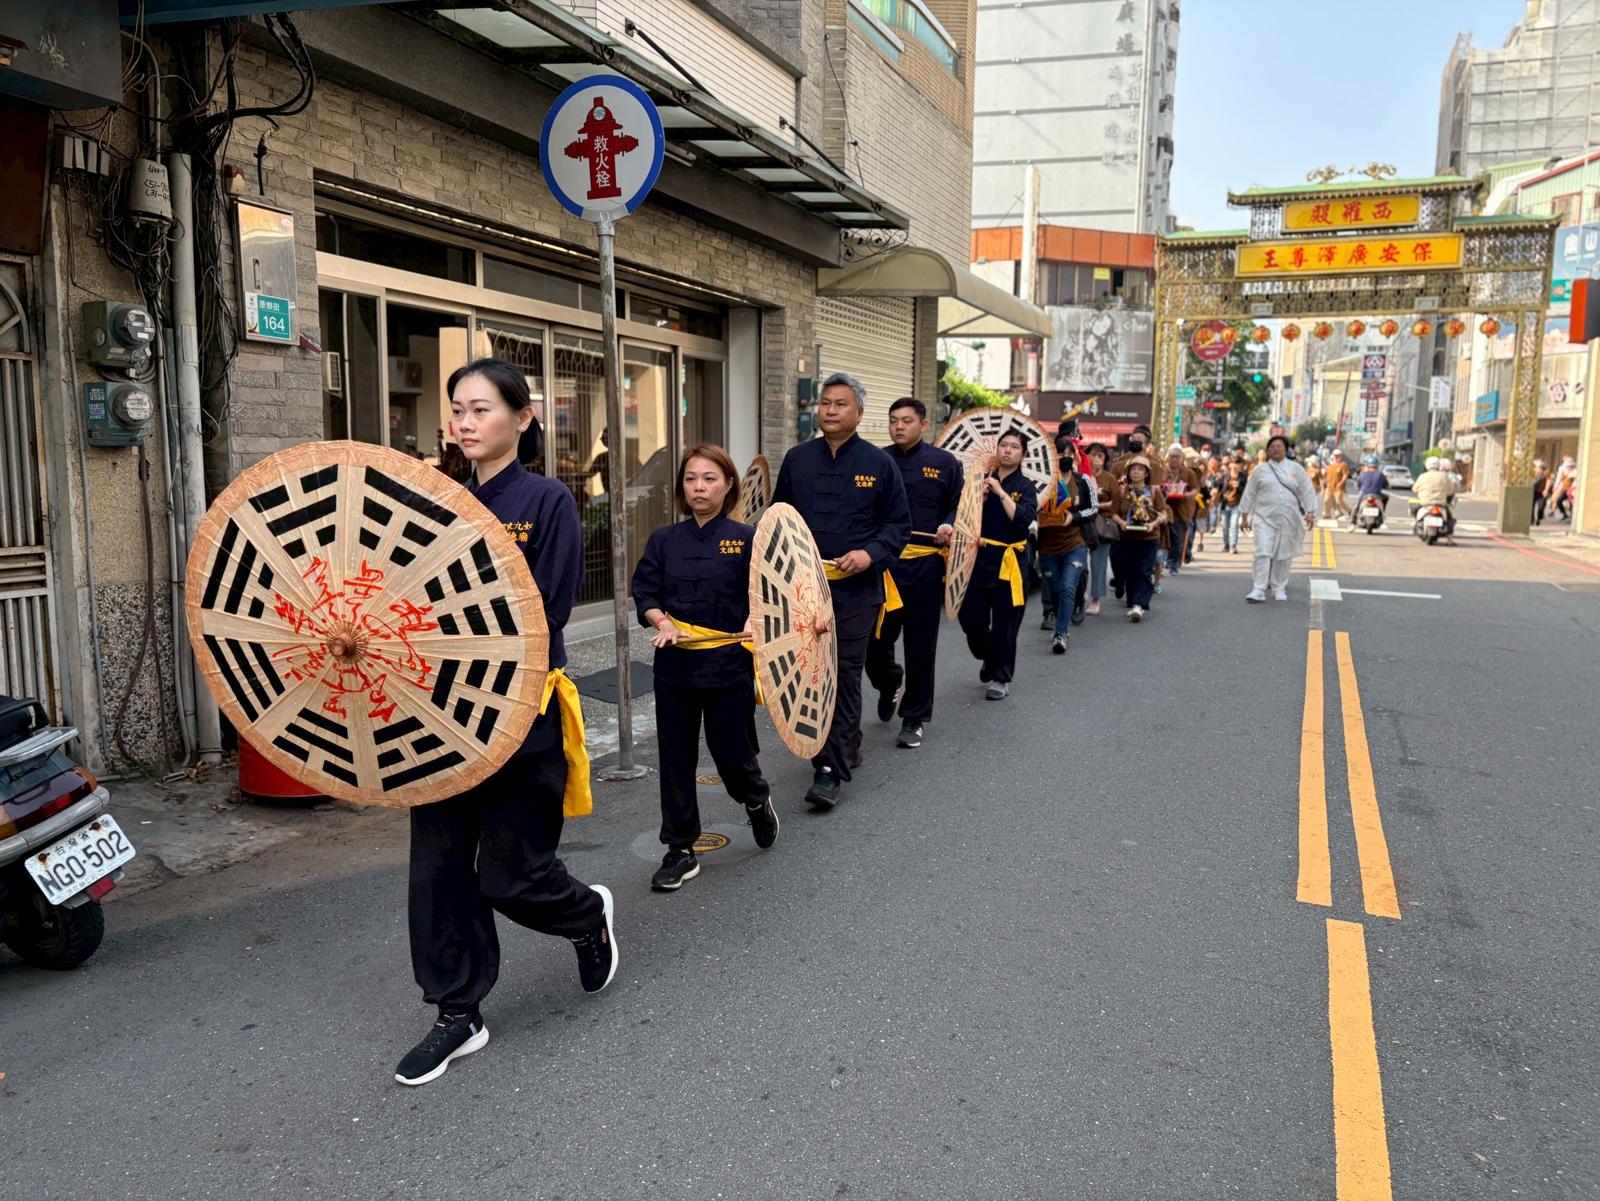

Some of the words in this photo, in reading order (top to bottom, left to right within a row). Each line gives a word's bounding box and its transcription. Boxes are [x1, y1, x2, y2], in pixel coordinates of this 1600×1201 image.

[593, 135, 611, 188] 救火栓
[263, 315, 285, 331] 164
